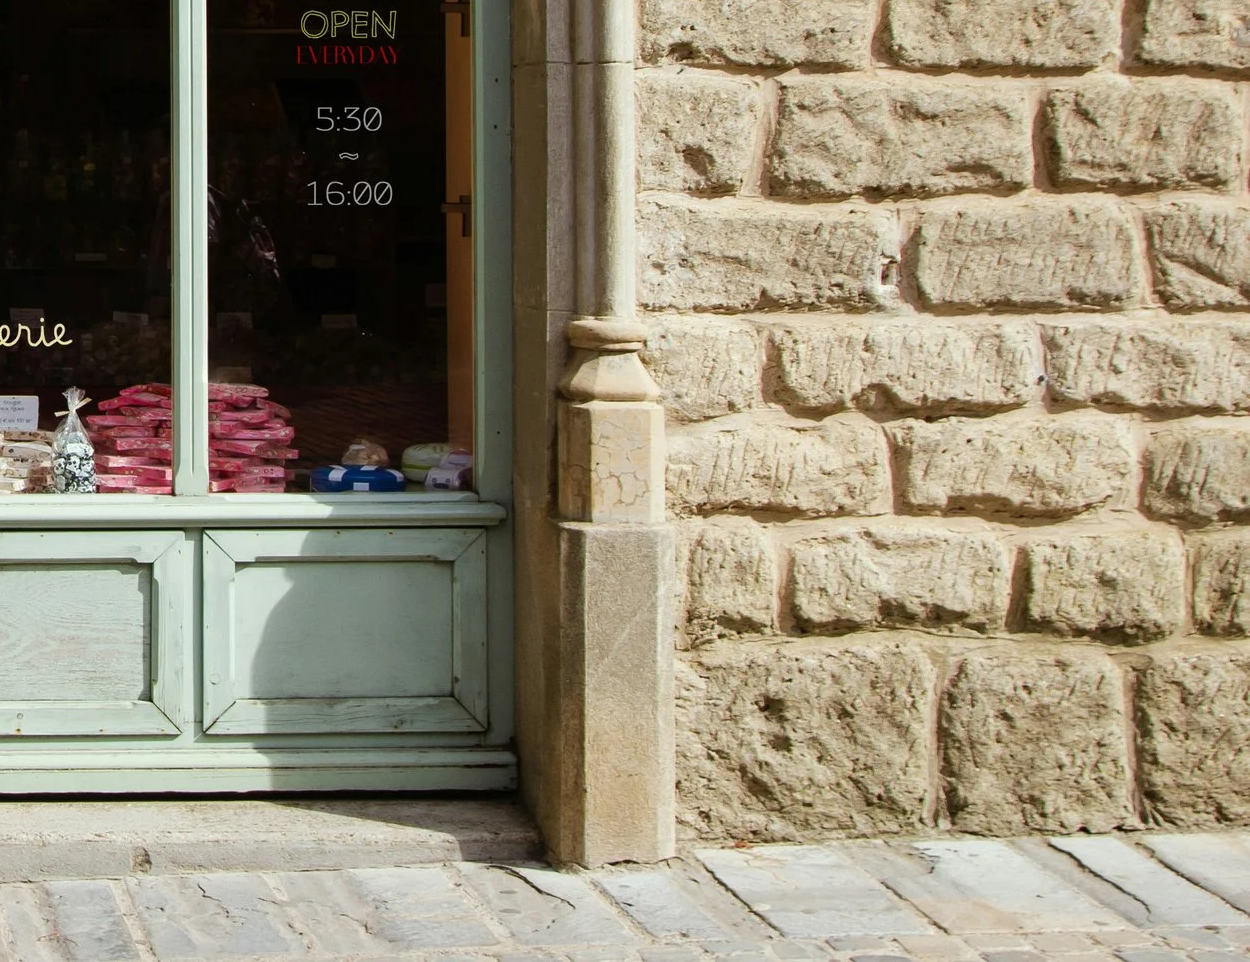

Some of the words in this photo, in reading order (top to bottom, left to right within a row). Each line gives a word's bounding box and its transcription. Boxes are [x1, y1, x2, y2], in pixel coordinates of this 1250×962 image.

[301, 10, 398, 39] OPEN
[296, 45, 401, 65] EVERYDAY
[315, 106, 383, 132] 5:30
[306, 180, 393, 206] 16:00
